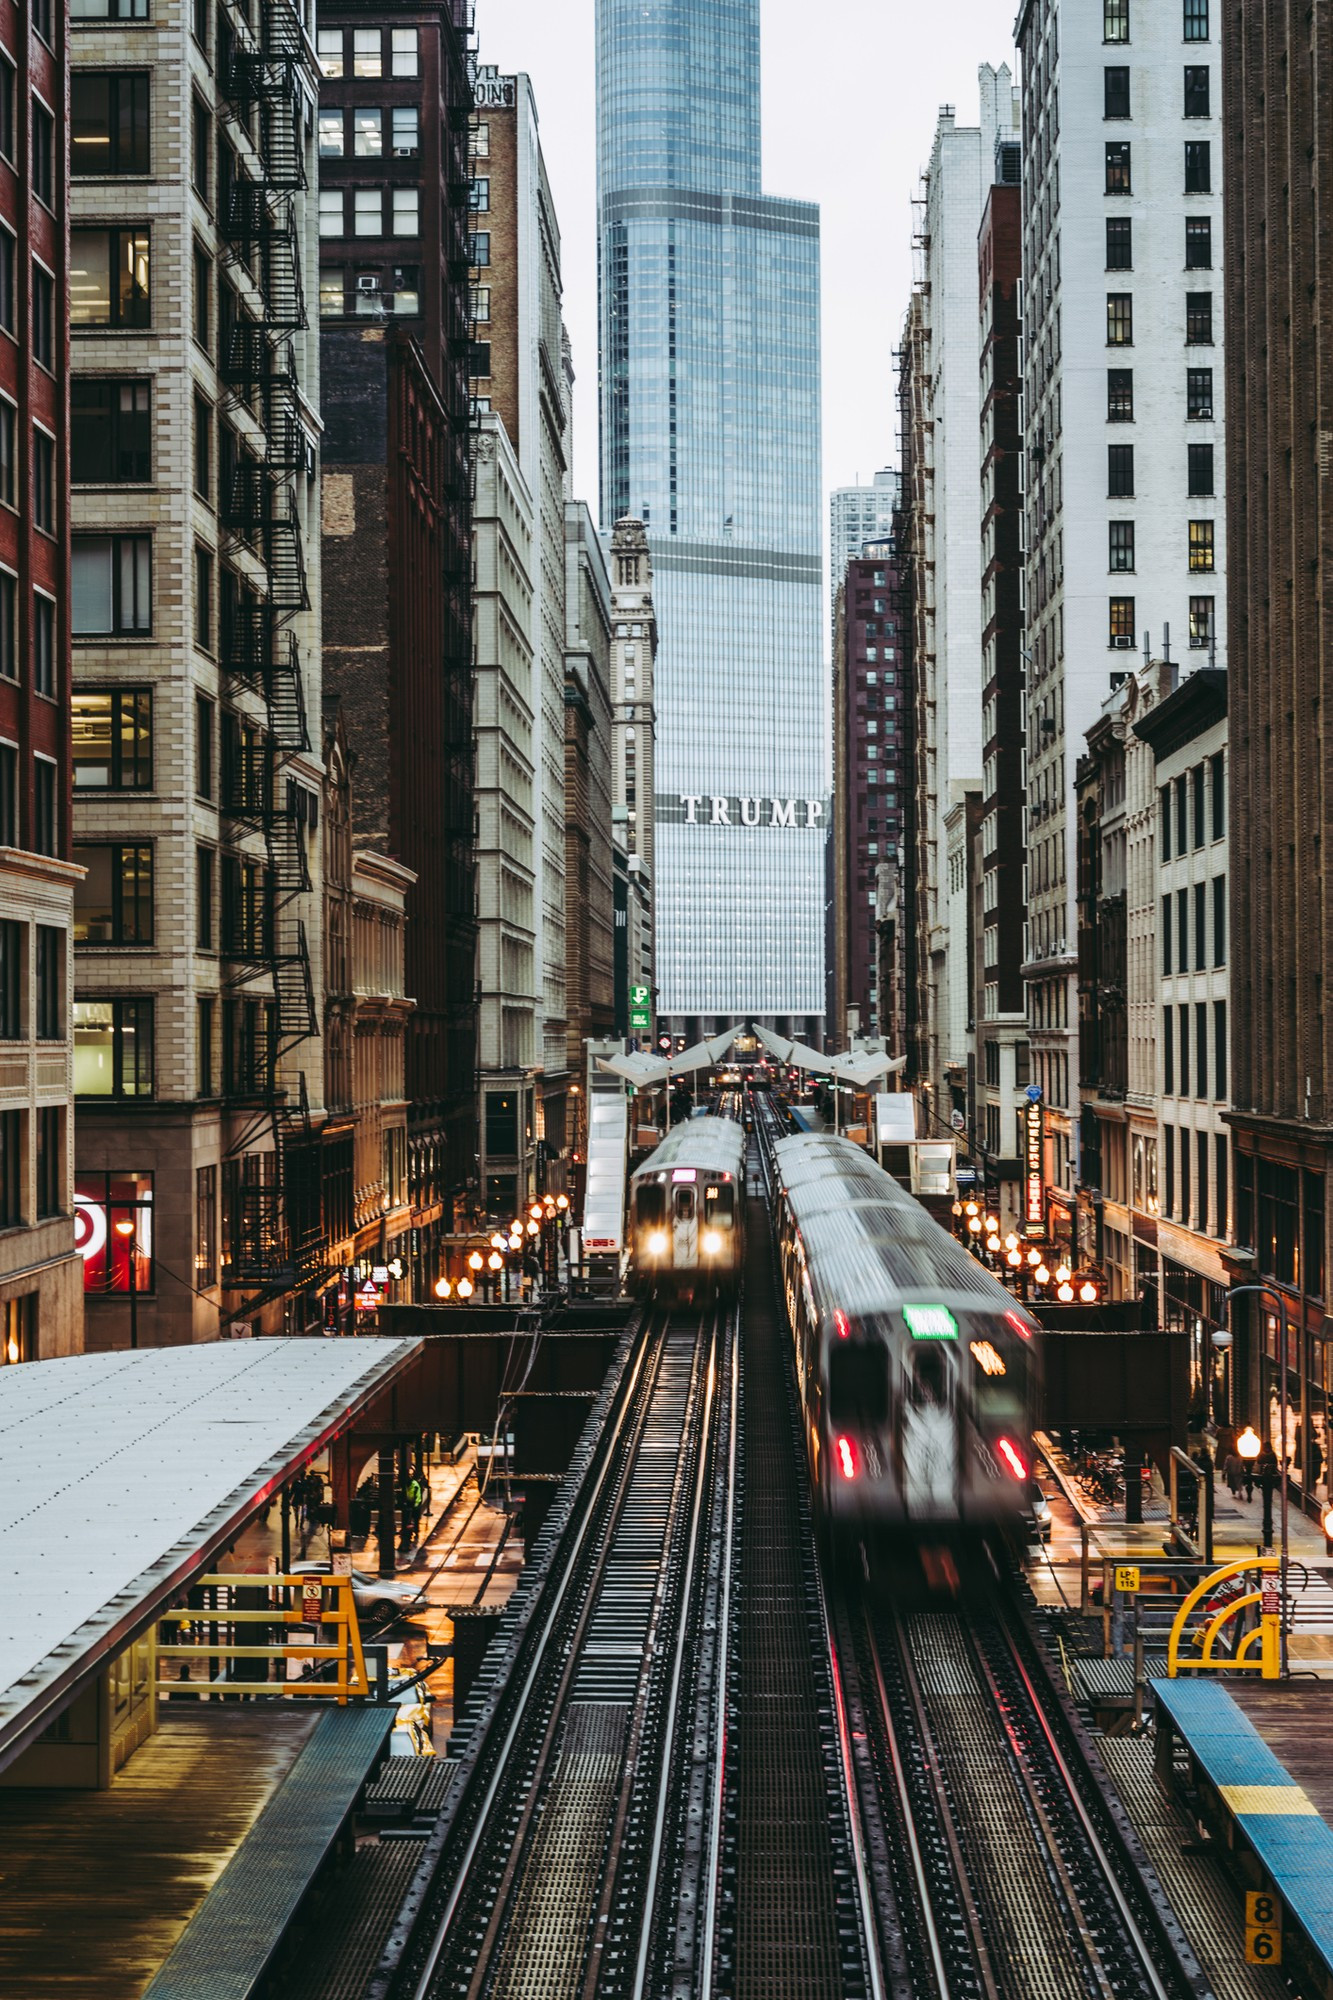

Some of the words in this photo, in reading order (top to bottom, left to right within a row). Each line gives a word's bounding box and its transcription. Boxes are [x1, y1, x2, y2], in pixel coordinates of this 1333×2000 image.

[680, 795, 823, 828] TRUMP
[1027, 1104, 1041, 1169] JEWELERS
[1028, 1171, 1041, 1220] CENTER
[1120, 1580, 1135, 1588] 115
[1254, 1897, 1274, 1923] 8
[1254, 1933, 1273, 1960] 6
